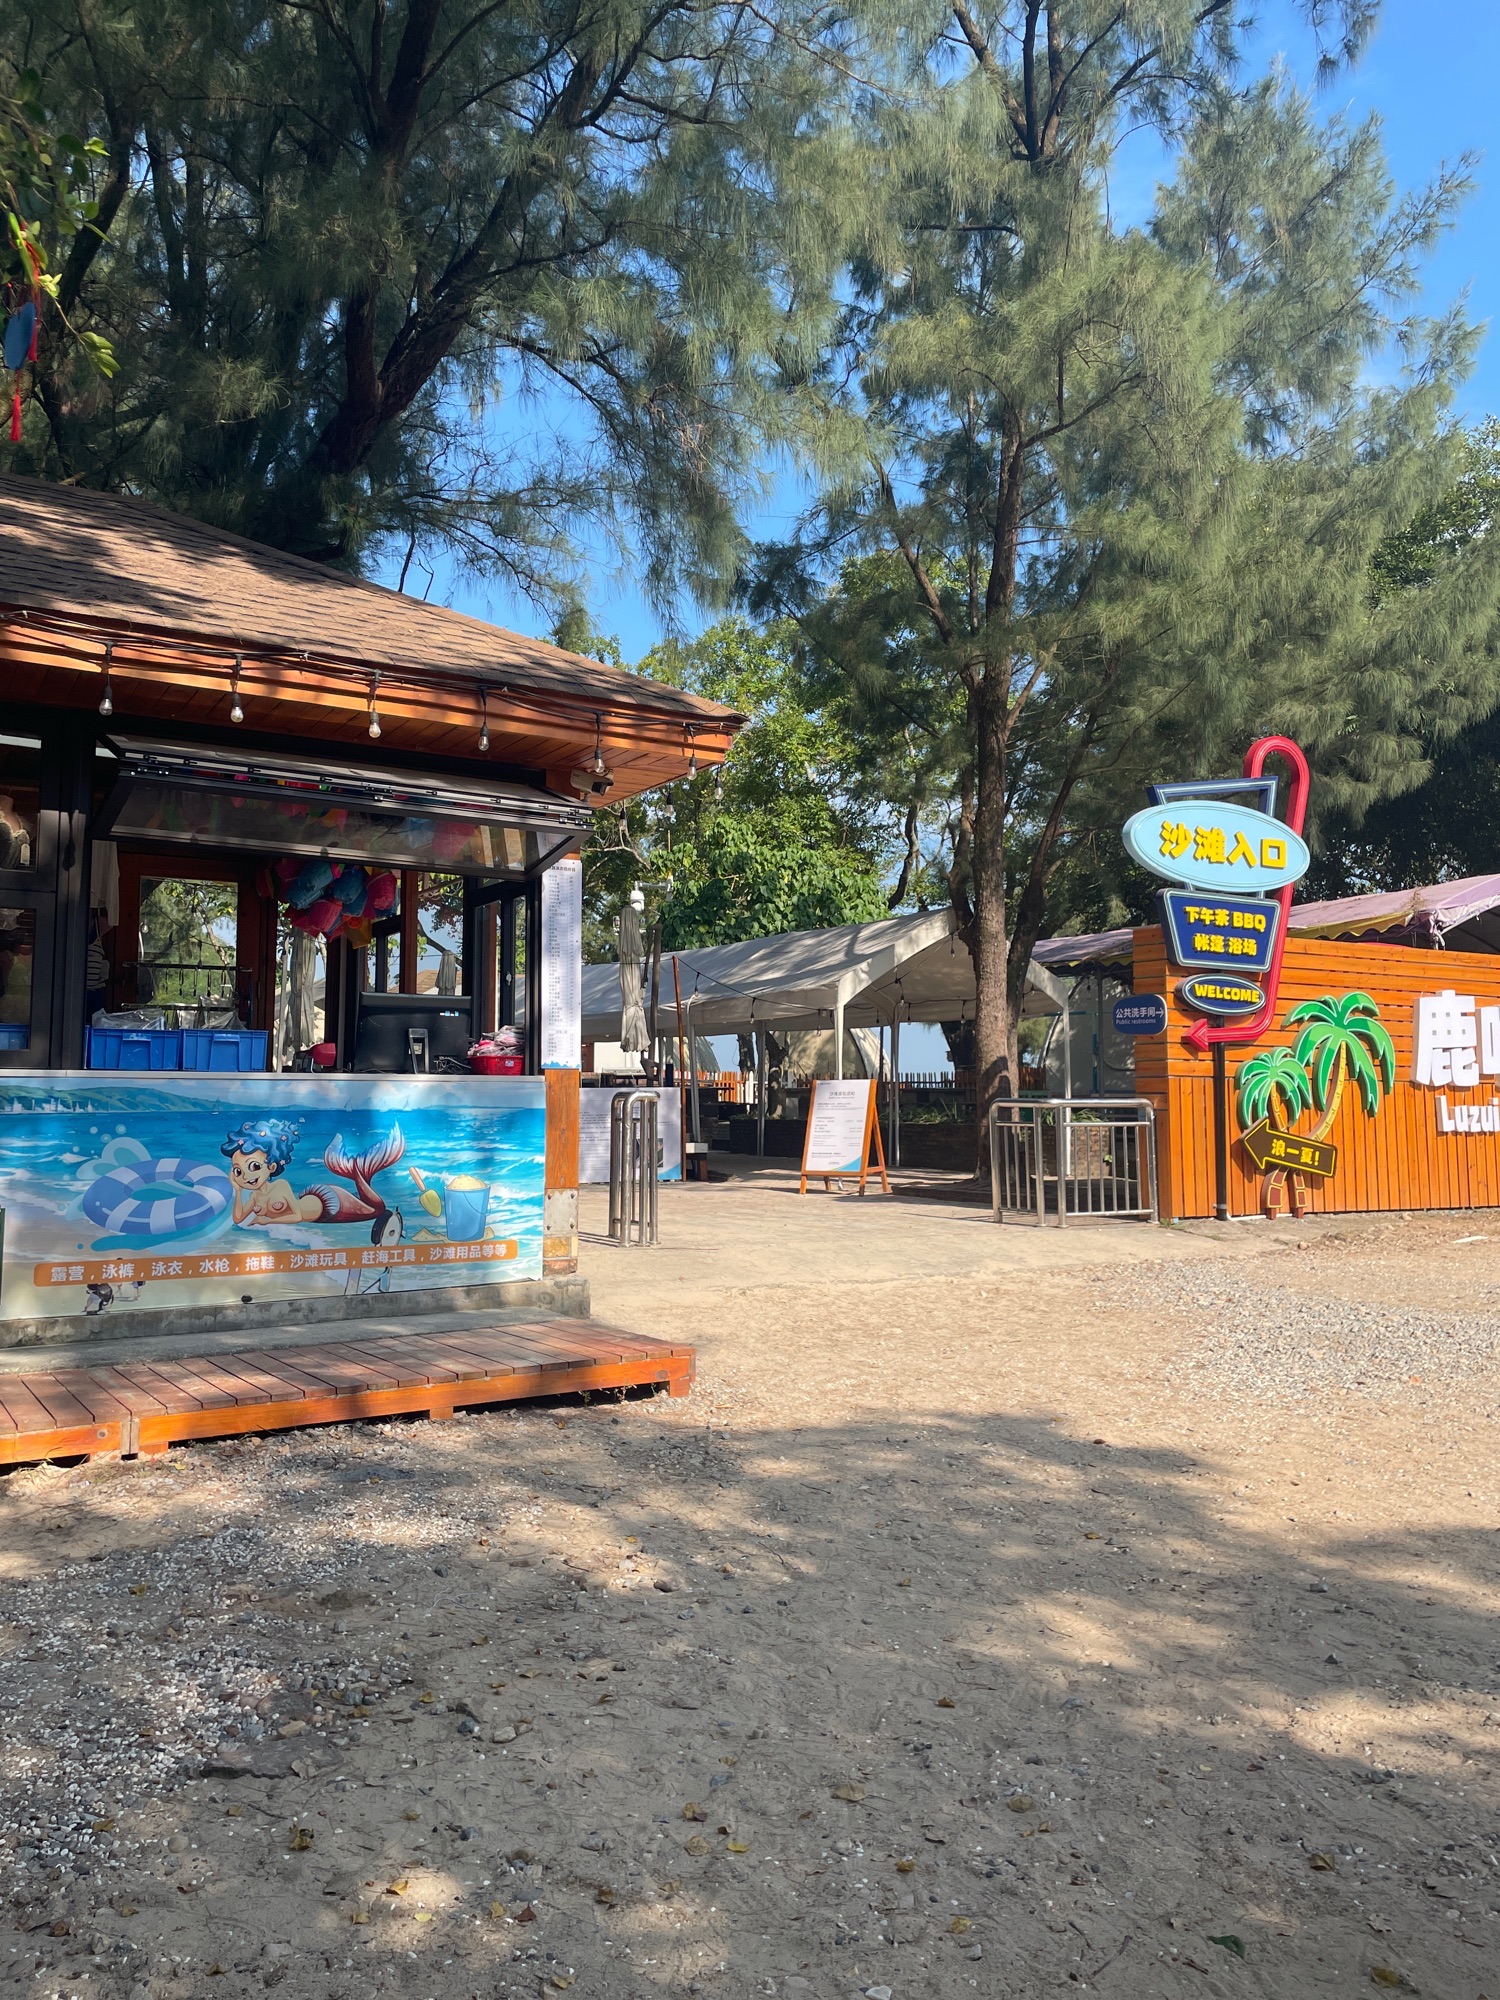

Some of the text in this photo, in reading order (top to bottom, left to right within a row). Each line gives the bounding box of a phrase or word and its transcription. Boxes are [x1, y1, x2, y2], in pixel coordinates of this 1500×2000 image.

[1159, 820, 1287, 870] 沙滩入口
[1184, 906, 1267, 932] 下午茶 BBQ
[1228, 937, 1257, 956] 浴场
[1194, 983, 1260, 1003] WELCOME
[1115, 1006, 1156, 1019] 公共洗手间
